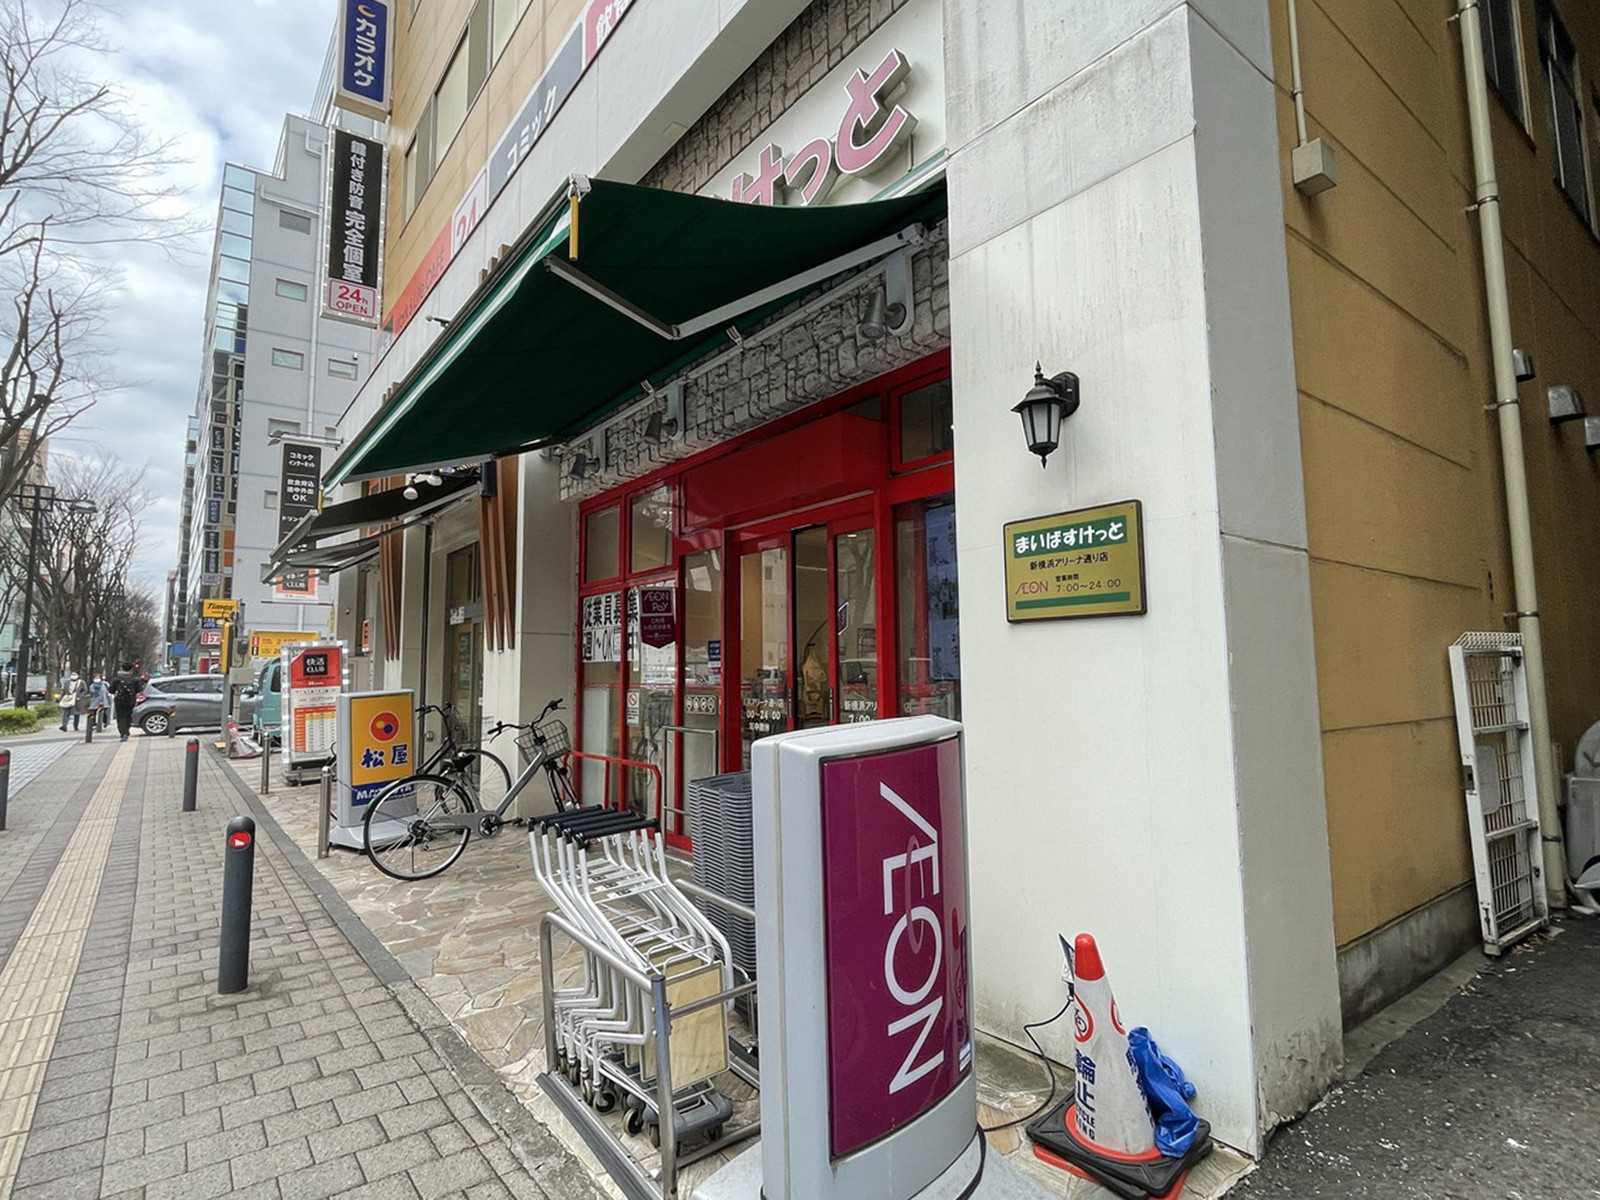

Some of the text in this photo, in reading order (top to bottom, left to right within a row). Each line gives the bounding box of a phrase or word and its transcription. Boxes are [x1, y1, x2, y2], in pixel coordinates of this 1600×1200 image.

[353, 17, 377, 88] カラオケ
[506, 84, 558, 181] コミック
[342, 210, 366, 284] 完全個室
[336, 300, 368, 314] OPEN
[292, 494, 307, 502] OK
[1015, 521, 1125, 555] まいばすけっと
[1030, 551, 1109, 571] 新横浜アリーナ通り店
[1055, 573, 1080, 583] 営業時間
[306, 665, 326, 674] CLUB
[361, 744, 409, 769] 松屋
